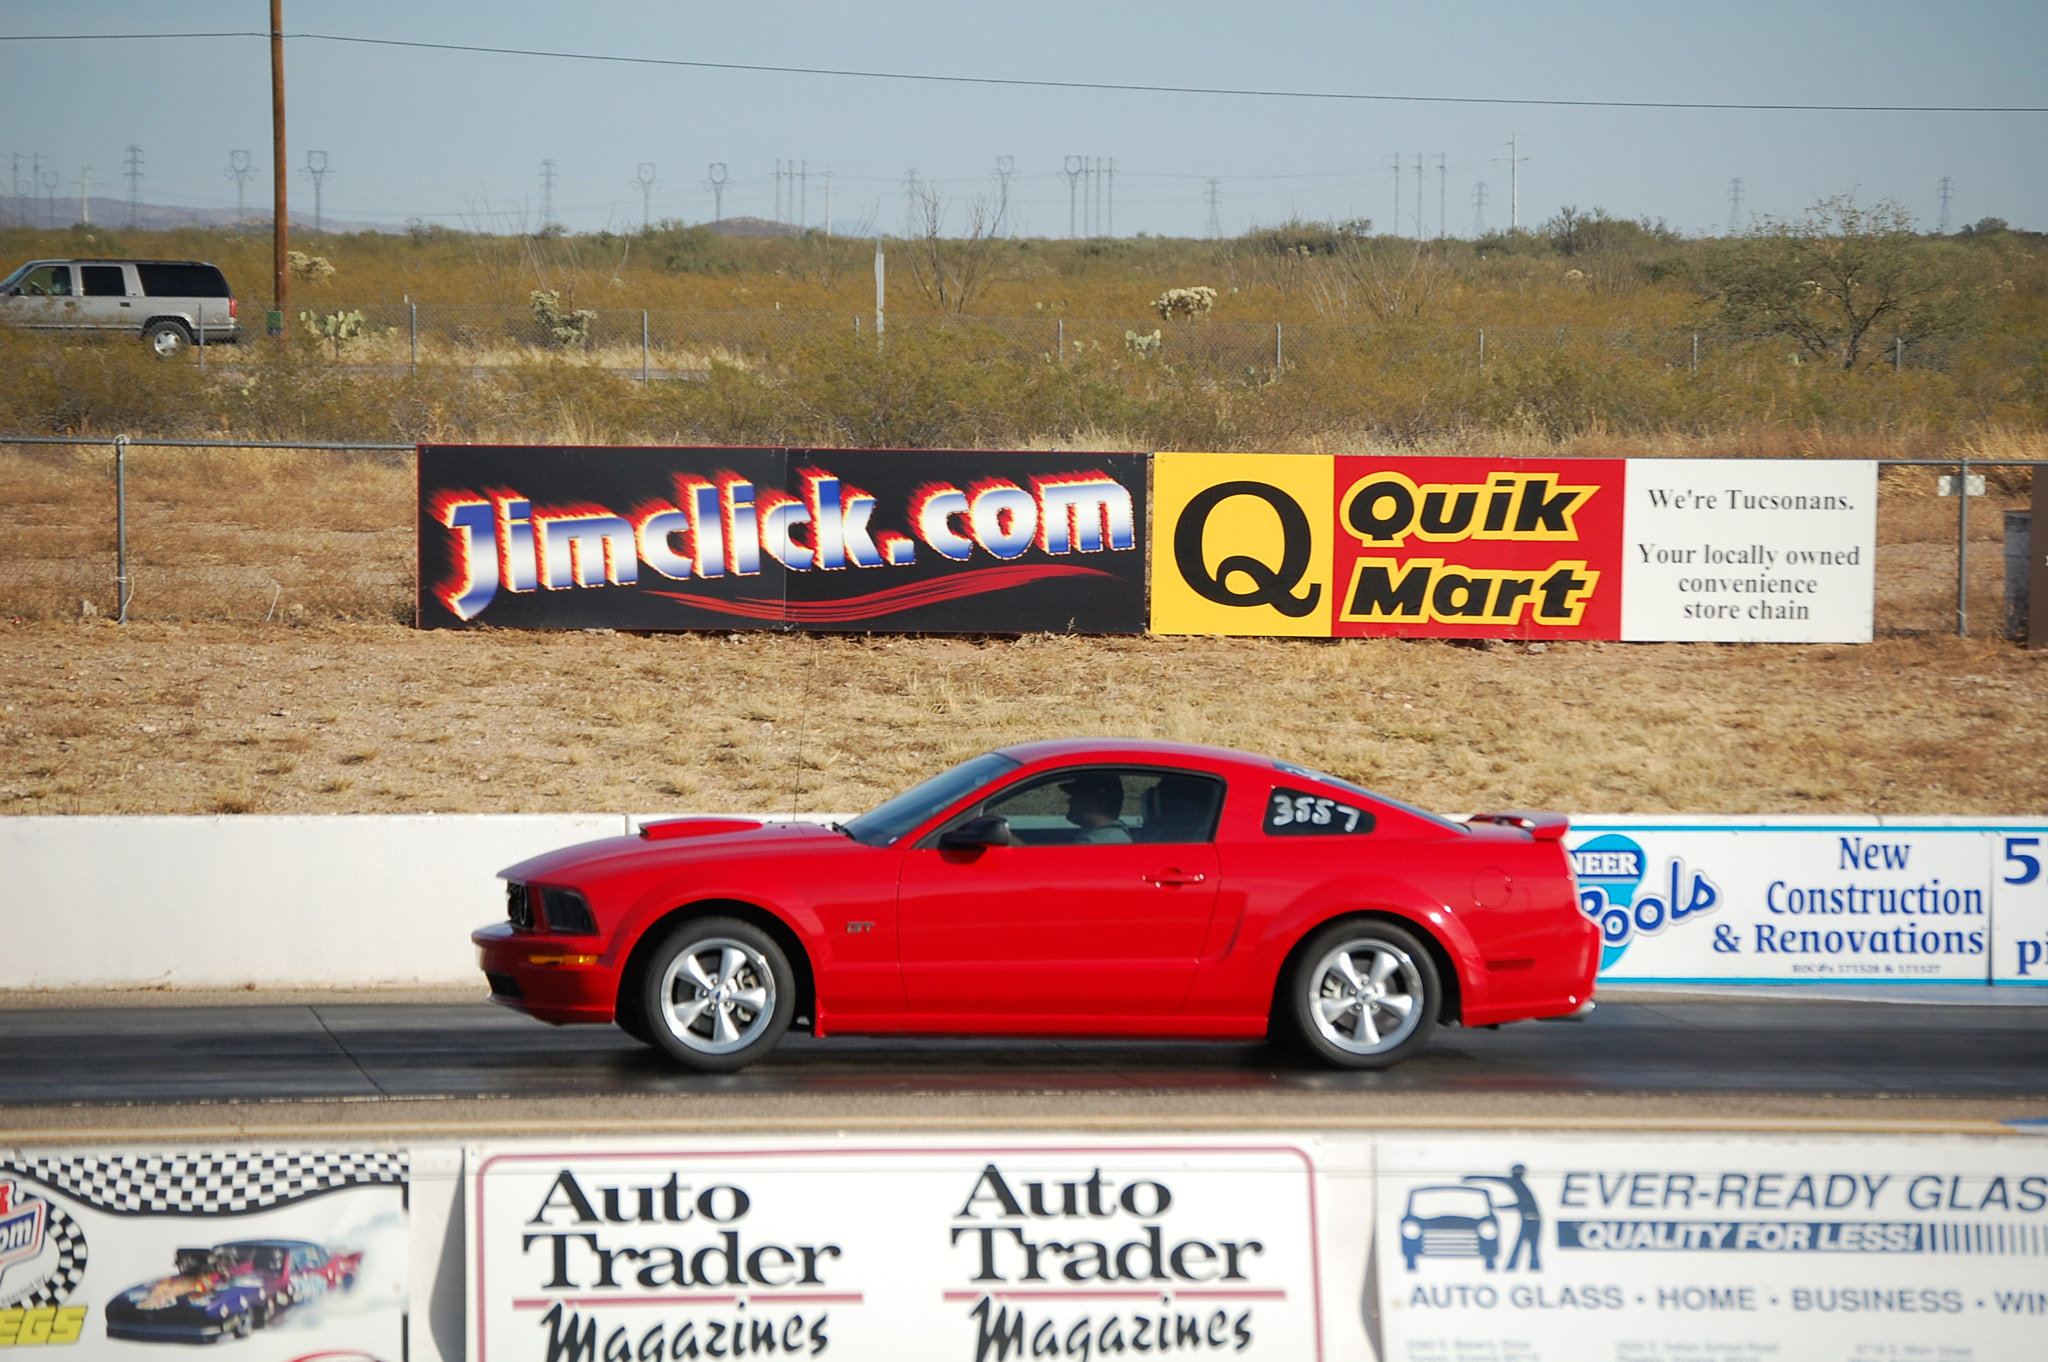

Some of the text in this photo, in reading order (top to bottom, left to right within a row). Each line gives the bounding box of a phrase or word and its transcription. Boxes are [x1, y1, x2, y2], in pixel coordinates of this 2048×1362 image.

[1344, 475, 1592, 544] Quik
[1648, 489, 1855, 510] We're Tucsonans.
[445, 470, 1137, 622] Jimclick.com
[1174, 480, 1322, 618] Q
[1638, 544, 1861, 570] Your locally owned
[1344, 563, 1594, 621] Mart
[1678, 573, 1819, 594] convenience
[1684, 600, 1810, 620] store chain
[1272, 794, 1361, 833] 3557
[1839, 837, 1911, 870] New
[1767, 879, 1984, 915] Construction
[846, 921, 876, 934] GT
[1712, 923, 1985, 955] & Renovations
[524, 1169, 750, 1226] Auto
[953, 1164, 1172, 1219] Auto
[1558, 1172, 2048, 1213] EVER-READY GLAS
[950, 1225, 1265, 1283] Trader
[1577, 1222, 1919, 1253] QUALITY FOR LESS!
[522, 1230, 842, 1289] Trader
[1408, 1285, 1498, 1310] AUTO
[1509, 1285, 1625, 1311] GLASS
[1657, 1287, 1758, 1312] HOME
[1791, 1288, 1964, 1314] BUSINESS
[540, 1300, 830, 1362] Magazines
[969, 1295, 1254, 1362] Magazines
